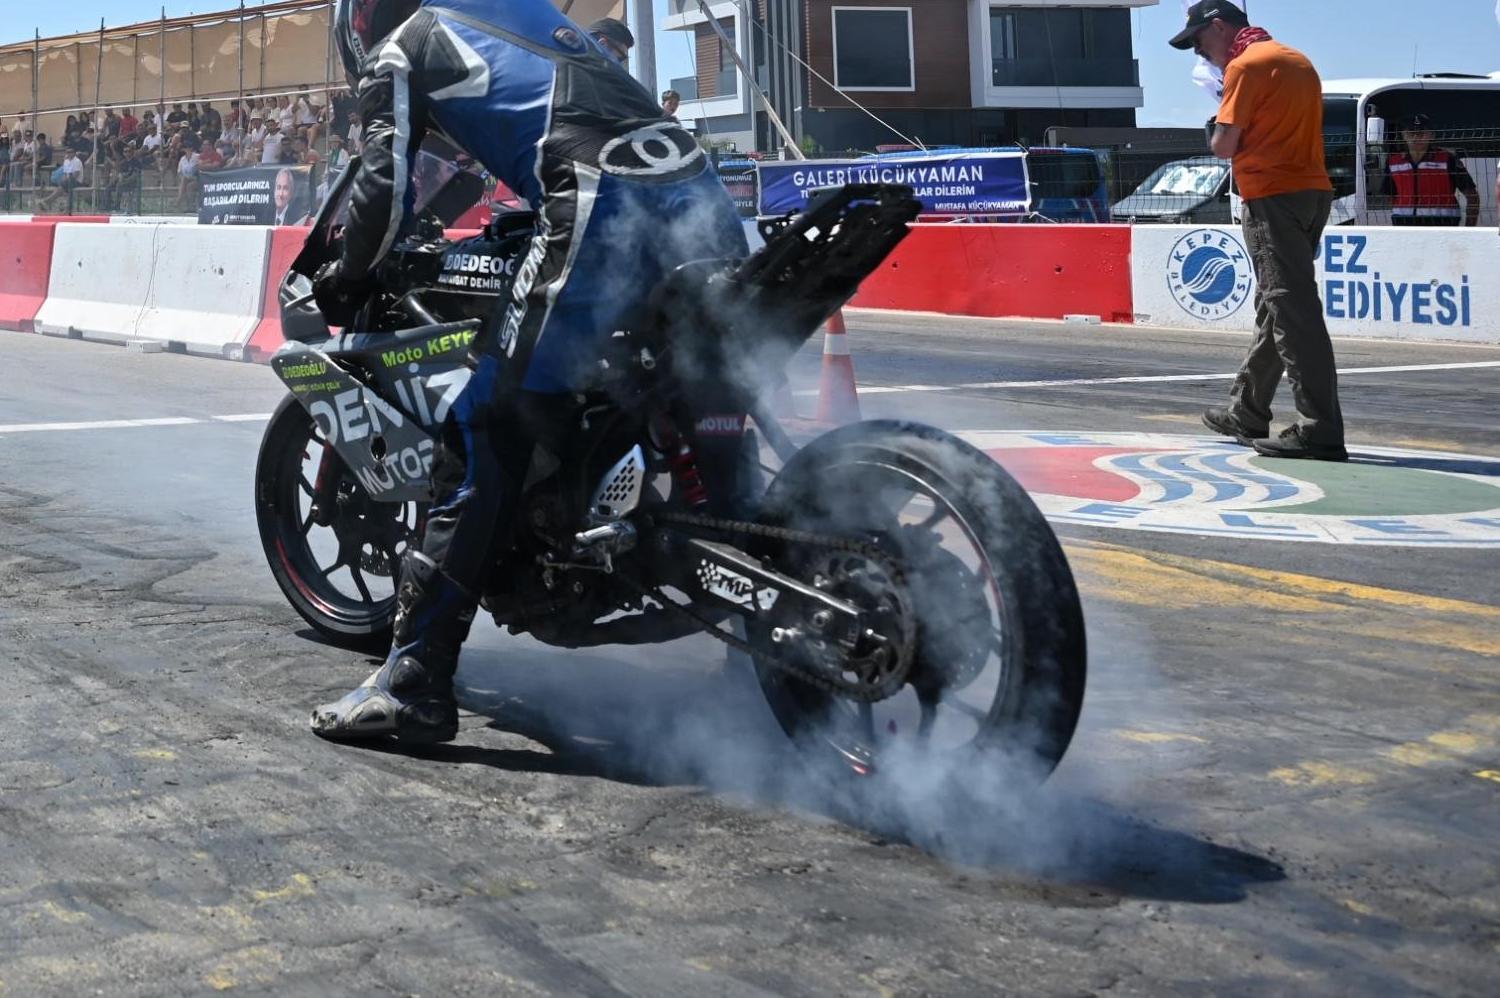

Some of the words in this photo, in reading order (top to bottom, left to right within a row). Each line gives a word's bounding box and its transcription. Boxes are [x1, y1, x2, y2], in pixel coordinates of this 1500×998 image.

[792, 166, 853, 187] GALERİ
[934, 184, 976, 197] DİLERİM
[934, 202, 967, 212] MUSTAFA
[1173, 233, 1245, 264] KEPEZ
[1170, 271, 1248, 316] BELEDİYESİ
[1325, 271, 1471, 327] EDİYESİ
[381, 346, 424, 370] Moto
[694, 417, 742, 432] MOTUL
